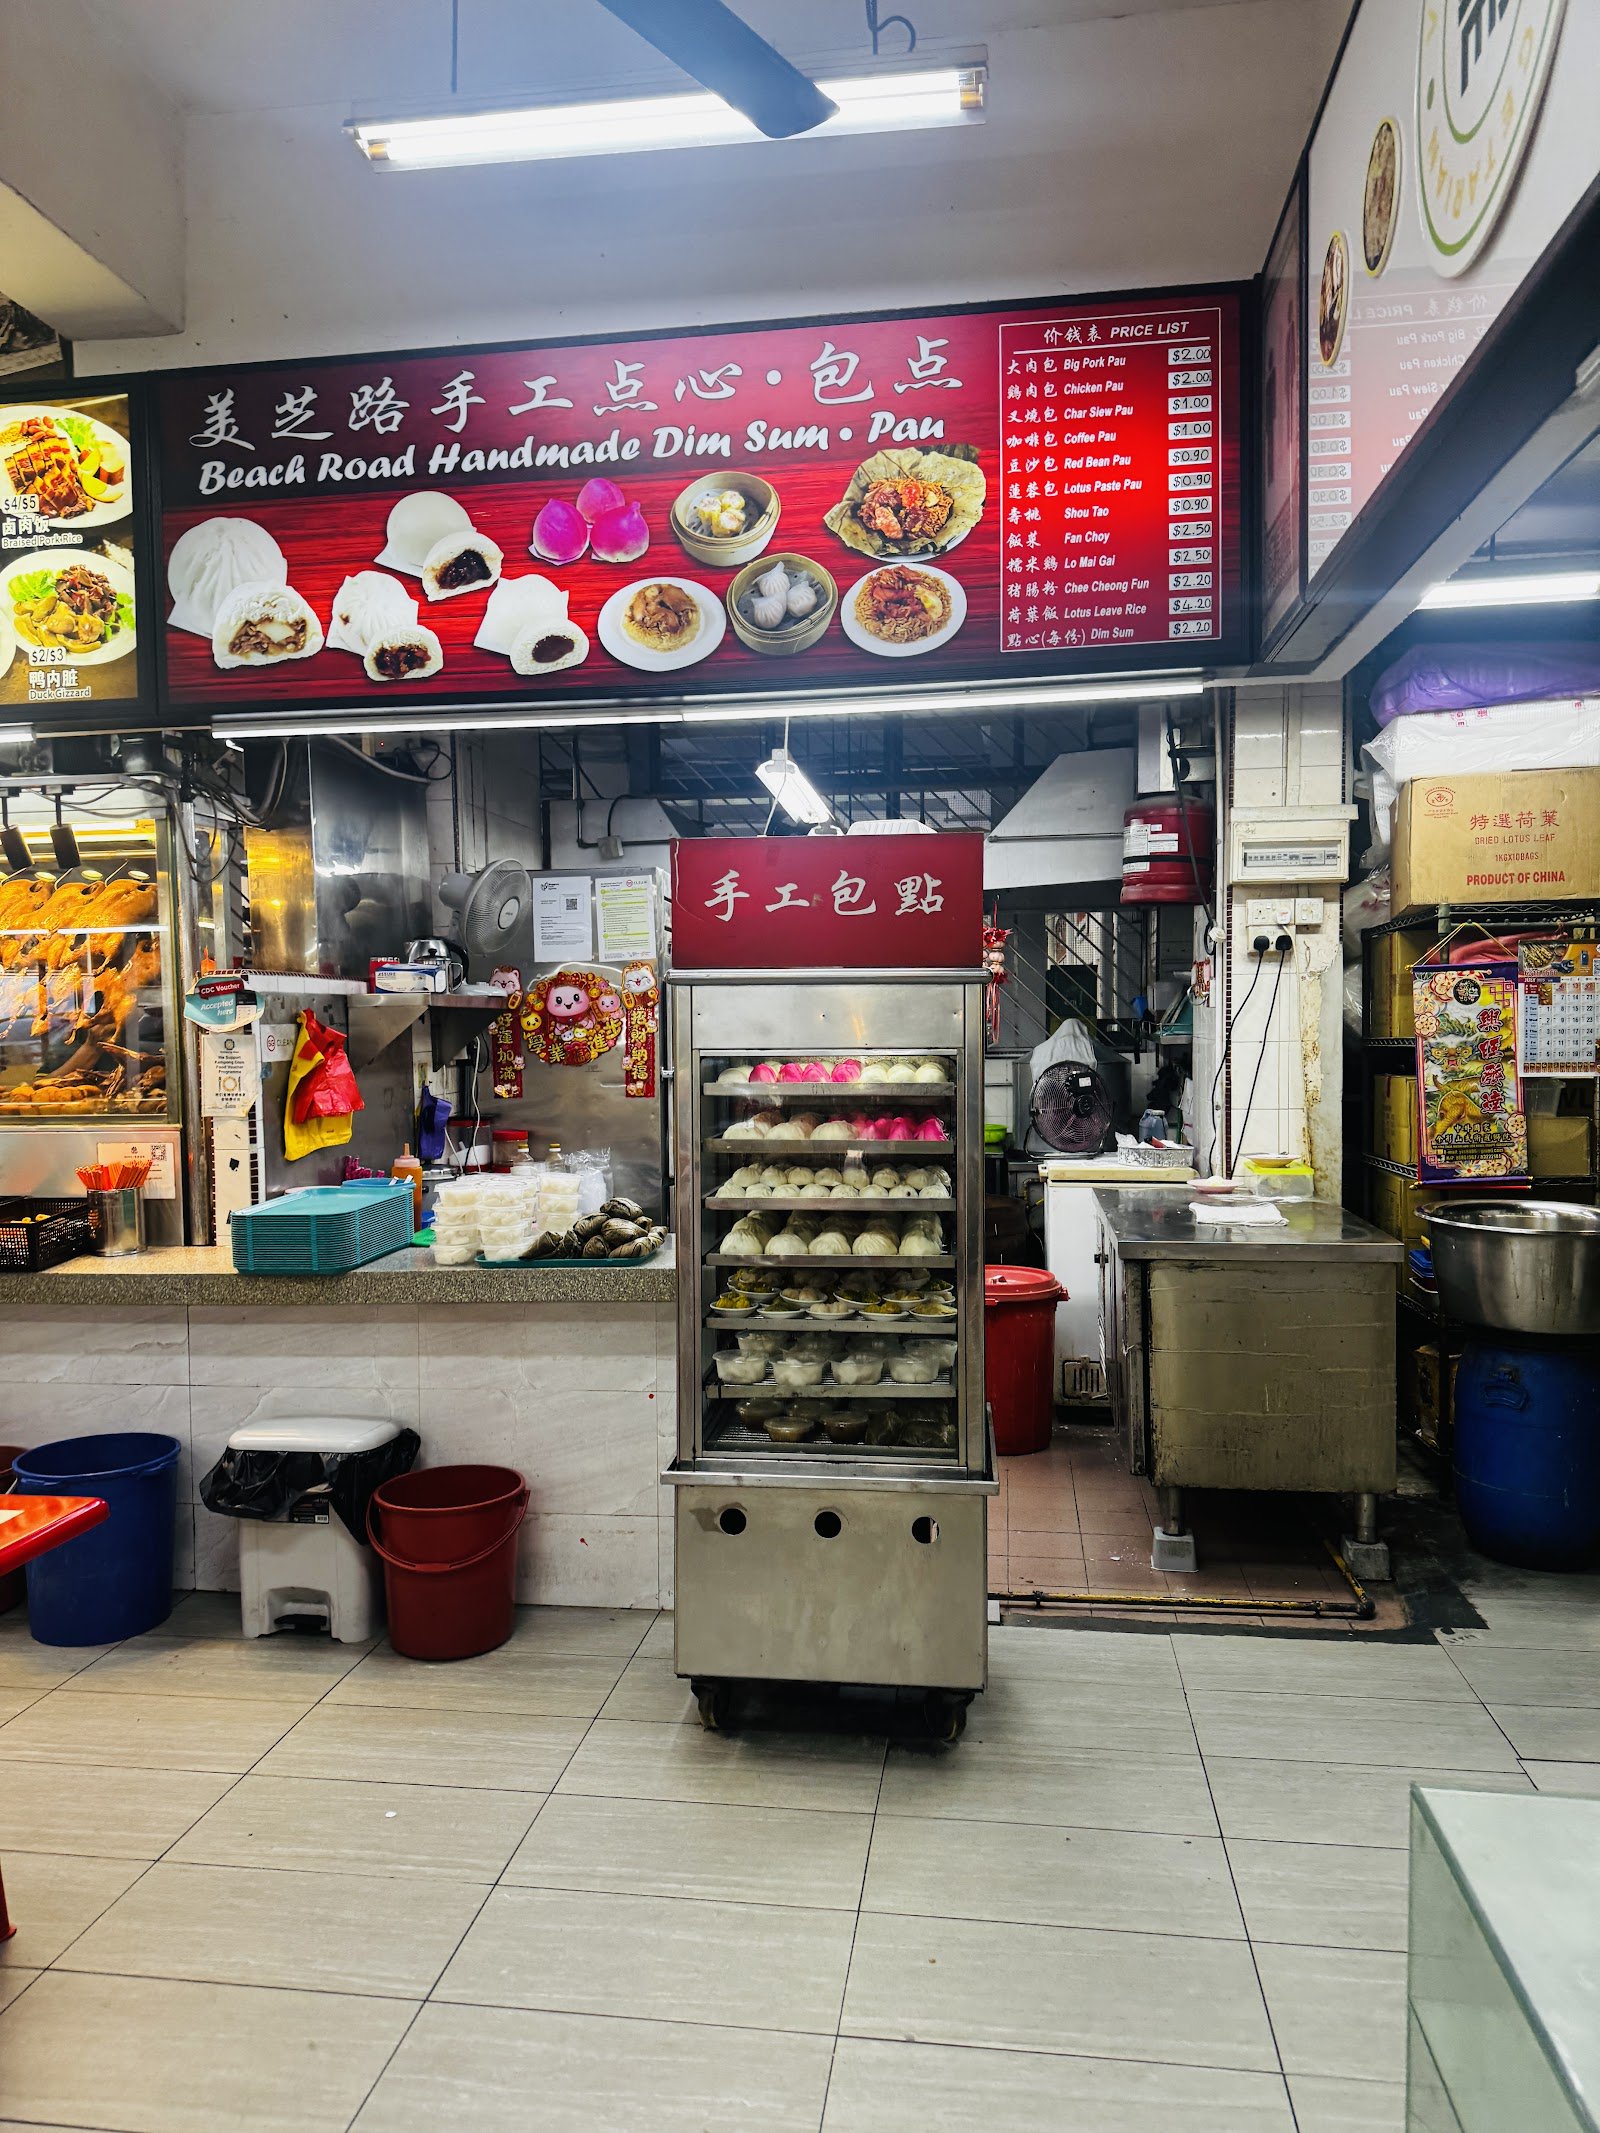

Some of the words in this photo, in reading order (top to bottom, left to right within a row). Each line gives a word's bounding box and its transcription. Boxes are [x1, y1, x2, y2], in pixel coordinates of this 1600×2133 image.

[1110, 325, 1153, 339] PRICE
[1157, 321, 1189, 335] LIST
[1006, 356, 1057, 375] 大肉包
[1063, 358, 1079, 372] Big
[1082, 357, 1105, 368] Pork
[1107, 355, 1126, 367] Pau
[1173, 348, 1210, 362] $2.00
[1064, 383, 1103, 395] Chicken
[1105, 380, 1124, 392] Pau
[1064, 408, 1087, 420] Char
[1089, 406, 1112, 418] Siew
[1114, 404, 1133, 416] Pau
[1173, 396, 1209, 411] $1.00
[1006, 431, 1058, 448] 咖啡包
[1064, 432, 1095, 445] Coffee
[1098, 430, 1117, 442] Pau
[1173, 422, 1211, 437] $1.00
[198, 454, 306, 495] Beach
[317, 444, 416, 482] Road
[428, 429, 642, 475] Handmade
[652, 425, 731, 458] Dim
[743, 420, 829, 452] Sum
[867, 410, 945, 443] Pau
[1007, 455, 1058, 474] 豆沙包
[1064, 457, 1083, 470] Red
[1085, 456, 1110, 468] Bean
[1112, 454, 1131, 466] Pau
[1173, 449, 1209, 463] $0.90
[1064, 482, 1092, 494] Lotus
[1094, 480, 1121, 493] Paste
[1123, 478, 1142, 490] Pau
[1173, 473, 1211, 488] $0.90
[4, 496, 36, 511] $4/$5
[1064, 507, 1089, 519] Shou
[1092, 506, 1109, 518] Tao
[1173, 498, 1209, 512] $0.90
[2, 515, 50, 536] 卤肉饭
[1064, 532, 1082, 544] Fan
[1085, 530, 1110, 545] Choy
[1173, 523, 1211, 537] $2.50
[3, 536, 37, 548] Braised
[39, 534, 60, 546] Pork
[61, 533, 82, 545] Rice
[1064, 557, 1077, 569] Lo
[1079, 556, 1096, 568] Mai
[1099, 555, 1115, 567] Gai
[1173, 549, 1210, 564] $2.50
[1064, 582, 1089, 594] Chee
[1091, 580, 1128, 593] Cheong
[1131, 578, 1150, 590] Fun
[1173, 574, 1211, 588] $2.20
[1064, 607, 1092, 619] Lotus
[1094, 605, 1123, 617] Leave
[1125, 603, 1147, 615] Rice
[1173, 598, 1211, 612] $4.20
[1091, 629, 1111, 640] Dim
[1112, 627, 1134, 639] Sum
[1173, 621, 1210, 635] $2.20
[31, 648, 64, 663] $2/$3
[29, 689, 54, 700] Duck
[55, 687, 91, 699] Gizzard
[1469, 809, 1560, 831] 特選荷葉
[1475, 835, 1499, 845] DRIED
[1503, 834, 1531, 844] LOTUS
[1533, 833, 1556, 843] LEAF
[1466, 872, 1516, 886] PRODUCT
[1517, 872, 1531, 884] OF
[1533, 870, 1565, 883] CHINA
[704, 868, 945, 922] 手工包點
[201, 986, 215, 995] CDC
[216, 983, 240, 992] Voucher
[200, 999, 234, 1011] Accepted
[217, 1007, 234, 1016] here
